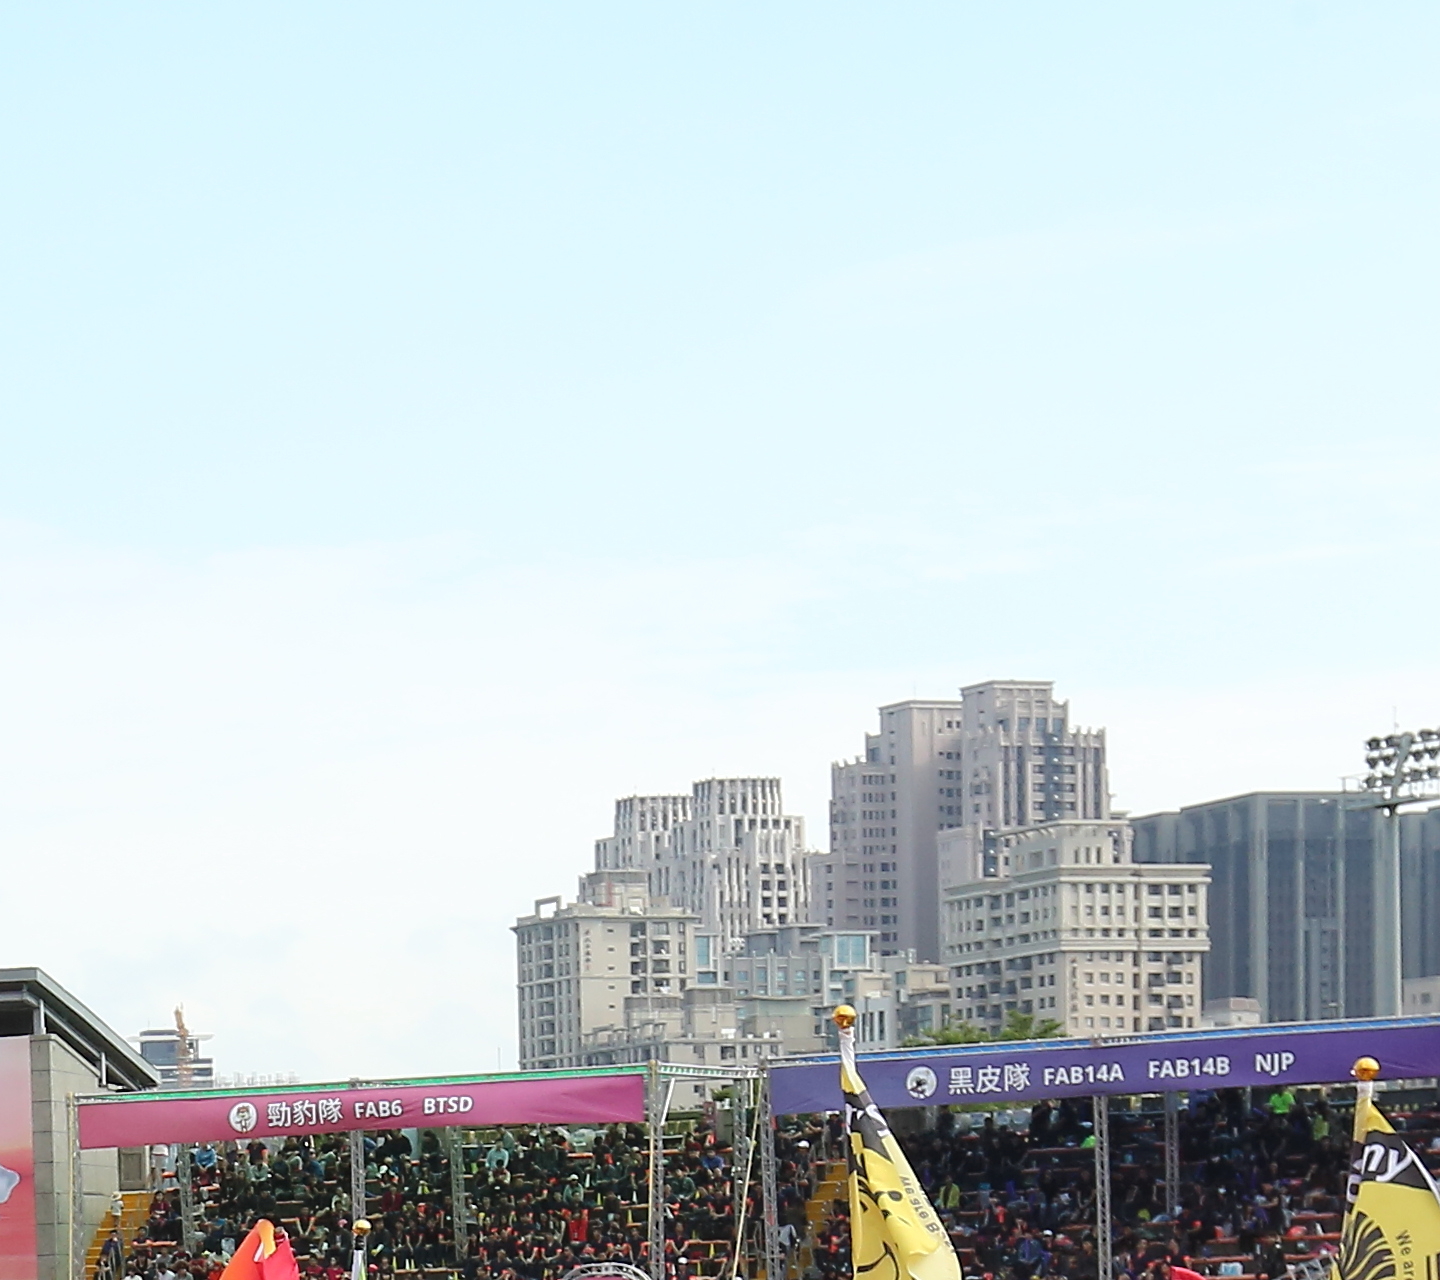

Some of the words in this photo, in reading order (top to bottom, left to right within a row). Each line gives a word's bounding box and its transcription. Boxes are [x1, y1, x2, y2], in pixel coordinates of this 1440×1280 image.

[948, 1063, 1031, 1094] 黑皮隊
[1043, 1062, 1125, 1086] FAB14A
[1147, 1055, 1232, 1079] FAB14B
[1254, 1051, 1296, 1076] NJP
[266, 1097, 344, 1128] 勁豹隊
[354, 1100, 403, 1119] FAB6
[423, 1095, 473, 1115] BTSD
